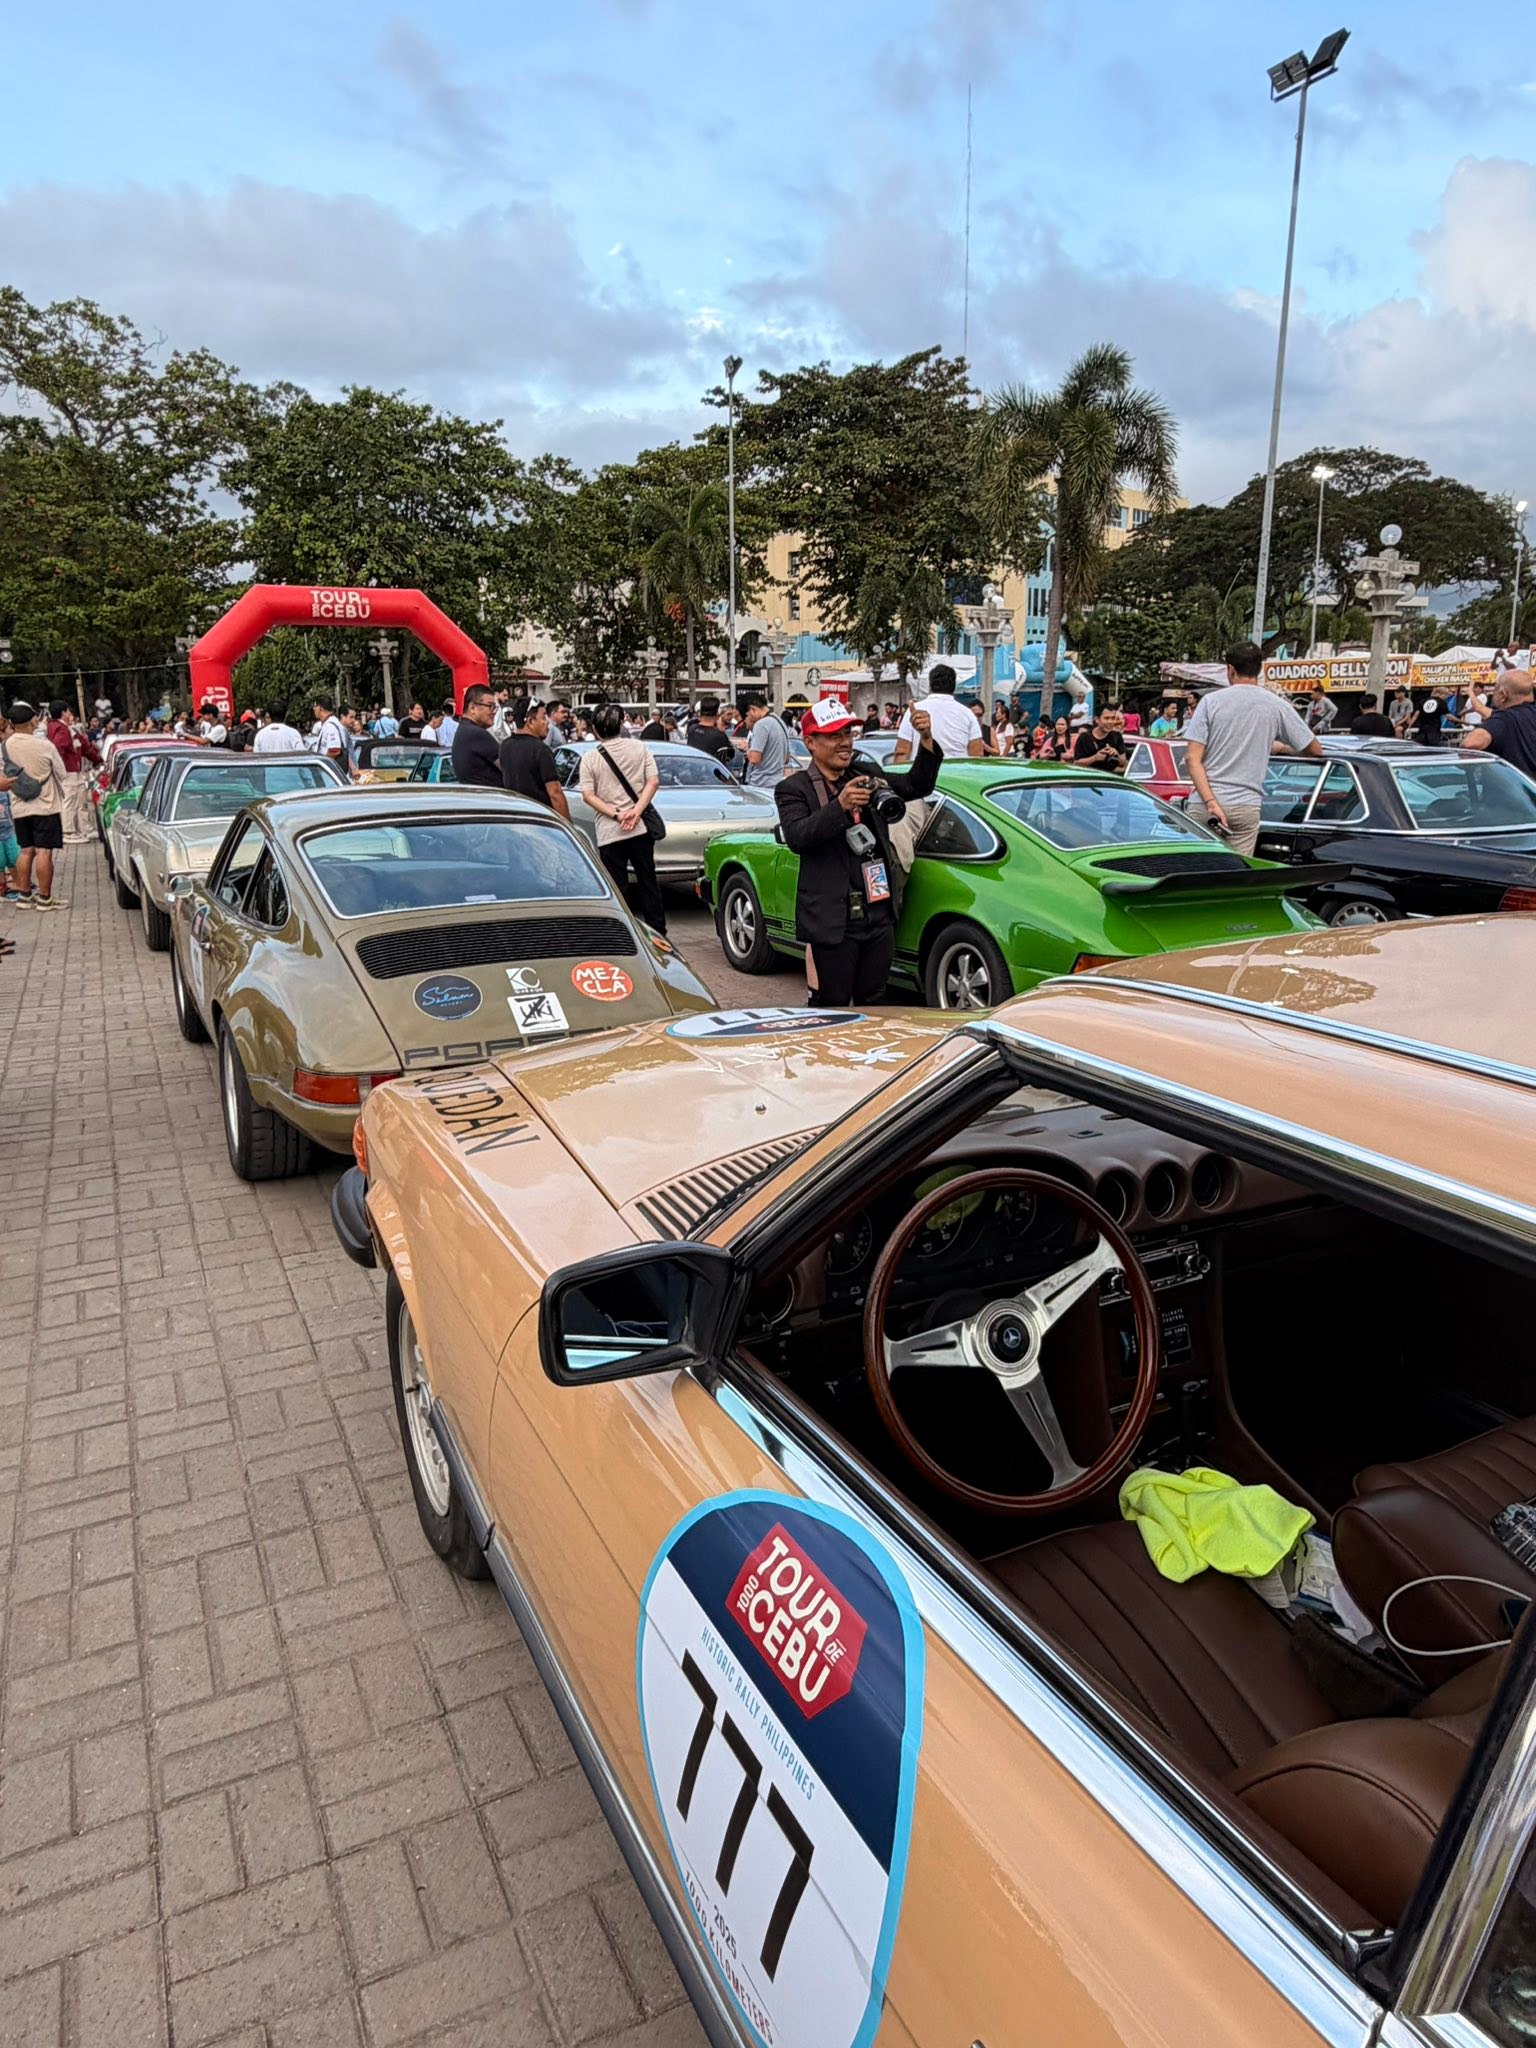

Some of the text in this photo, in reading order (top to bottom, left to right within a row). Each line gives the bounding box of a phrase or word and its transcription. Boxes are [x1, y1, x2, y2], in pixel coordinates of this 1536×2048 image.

[310, 590, 361, 604] TOUR
[320, 603, 370, 618] CEBU
[1267, 663, 1327, 679] QUADROS
[576, 967, 625, 981] MEZ
[583, 980, 627, 993] CLA
[413, 1071, 541, 1156] QUEDAN
[736, 1574, 760, 1614] 1000
[756, 1536, 846, 1664] TOUR DE
[748, 1589, 831, 1702] CEBU
[701, 1626, 816, 1801] HISTORIC RALLY PHILIPPINES
[676, 1648, 815, 1984] 777
[685, 1869, 774, 2046] 1000 KILOMETERS
[714, 1903, 737, 1960] 2025
